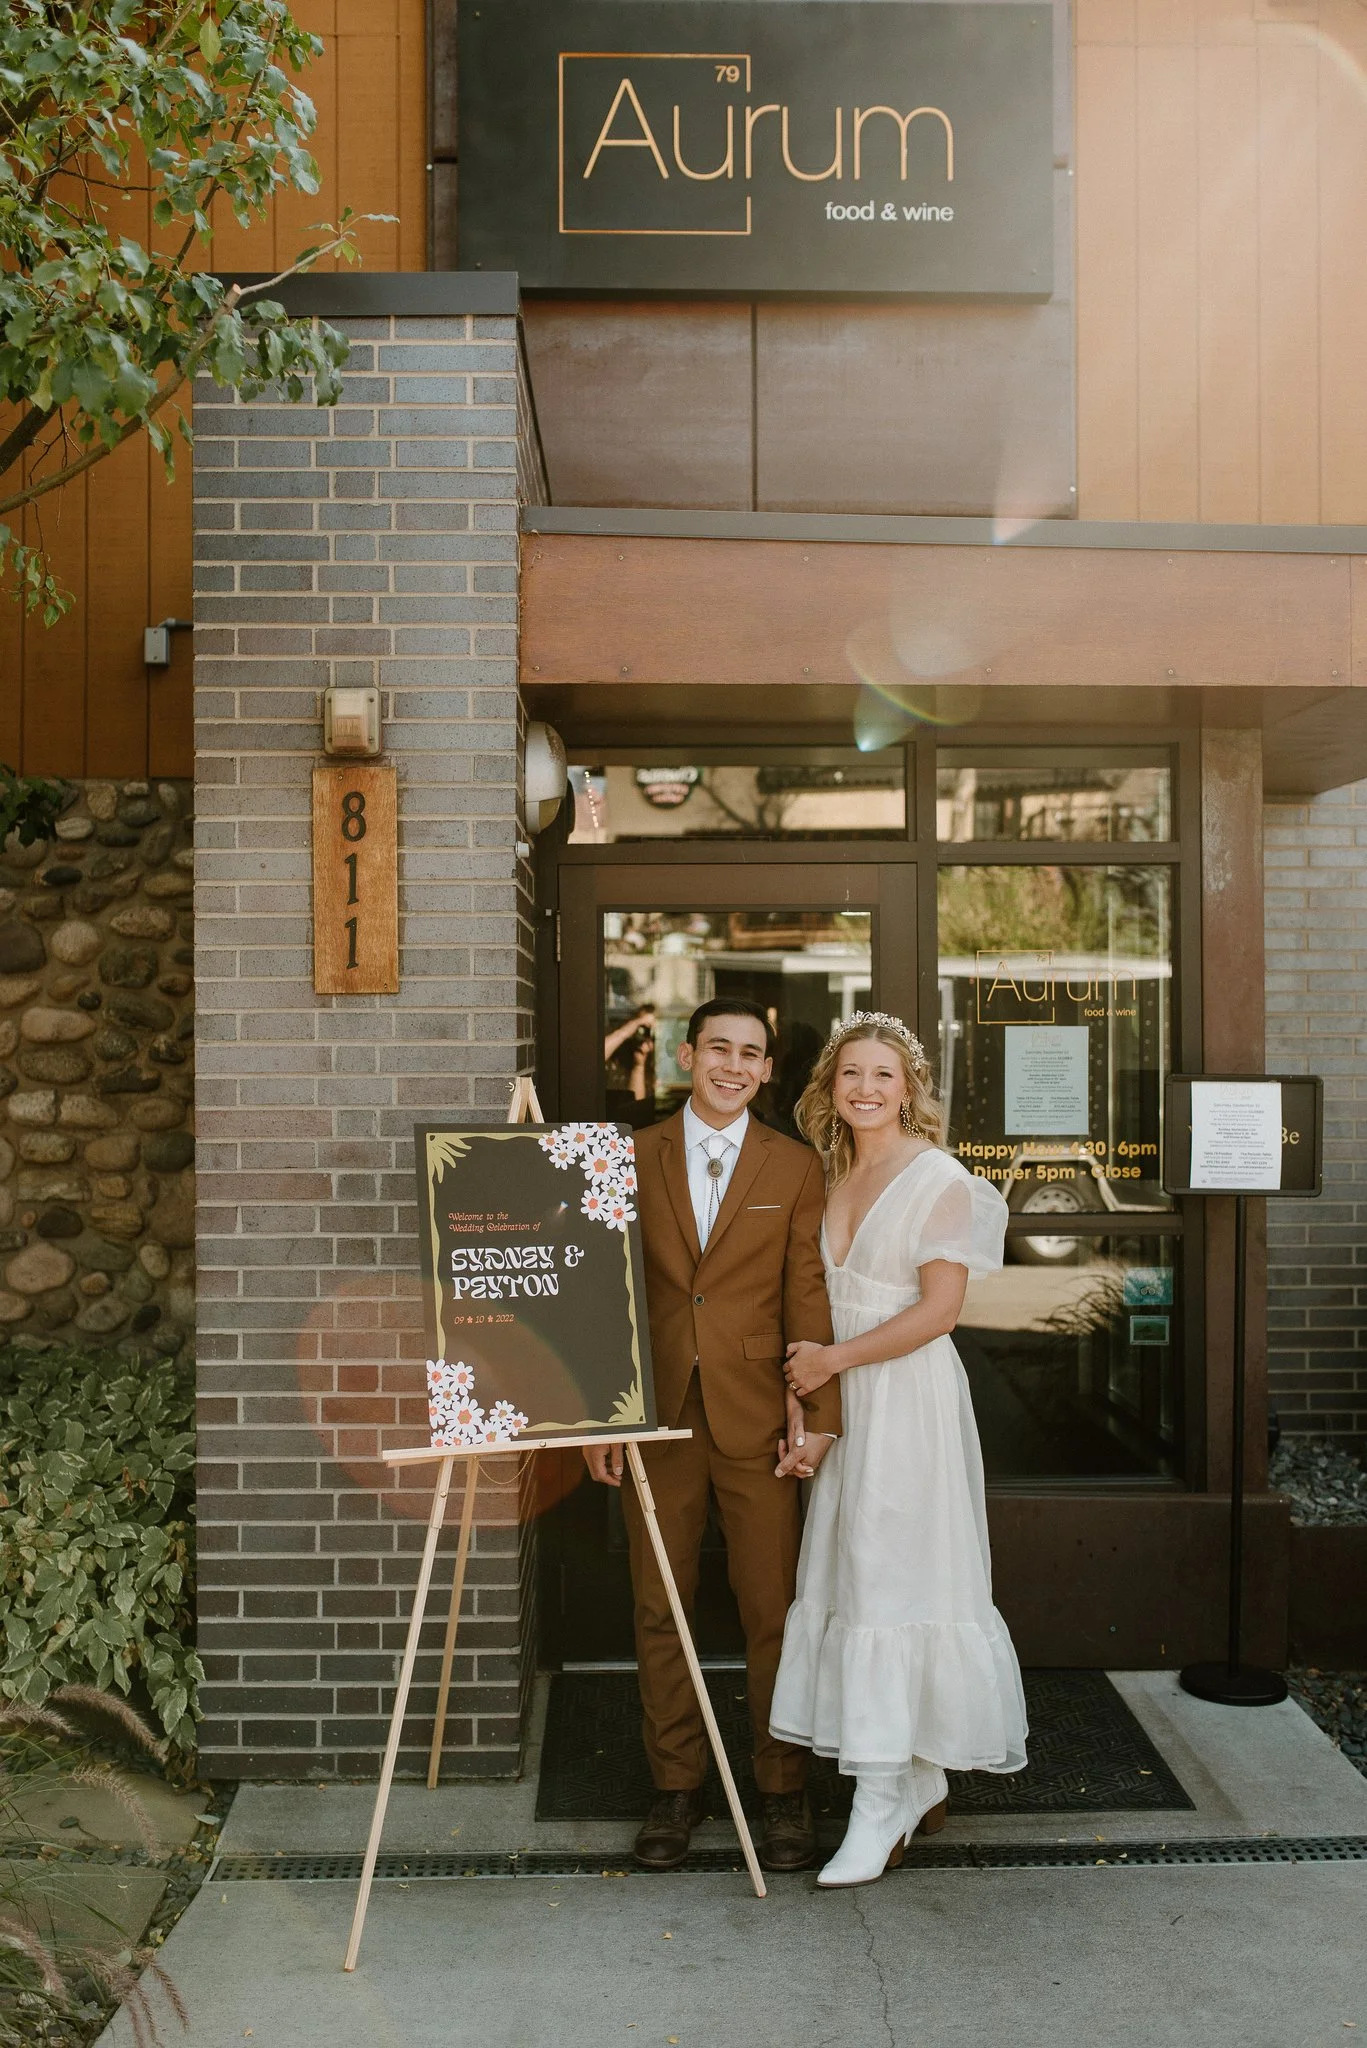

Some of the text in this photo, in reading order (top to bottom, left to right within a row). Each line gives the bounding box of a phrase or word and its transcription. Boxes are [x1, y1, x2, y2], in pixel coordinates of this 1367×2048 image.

[714, 65, 741, 83] 79
[583, 78, 954, 182] Aurum
[824, 200, 954, 221] food & wine
[341, 791, 367, 970] 811
[987, 960, 1136, 1002] Aurum
[1084, 1007, 1105, 1017] food
[1115, 1007, 1137, 1017] wine
[958, 1142, 1017, 1160] Happy
[1022, 1141, 1064, 1156] Hour
[1118, 1141, 1157, 1158] 6pm
[973, 1165, 1032, 1180] Dinner
[1036, 1164, 1076, 1182] 5pm
[1091, 1163, 1142, 1179] Close
[448, 1212, 483, 1221] Welcome
[497, 1211, 509, 1220] the
[448, 1221, 541, 1234] Wedding Celebration of
[451, 1245, 585, 1272] SYDNEY &
[452, 1273, 559, 1300] PEYTON
[454, 1313, 515, 1325] 09 10 2022
